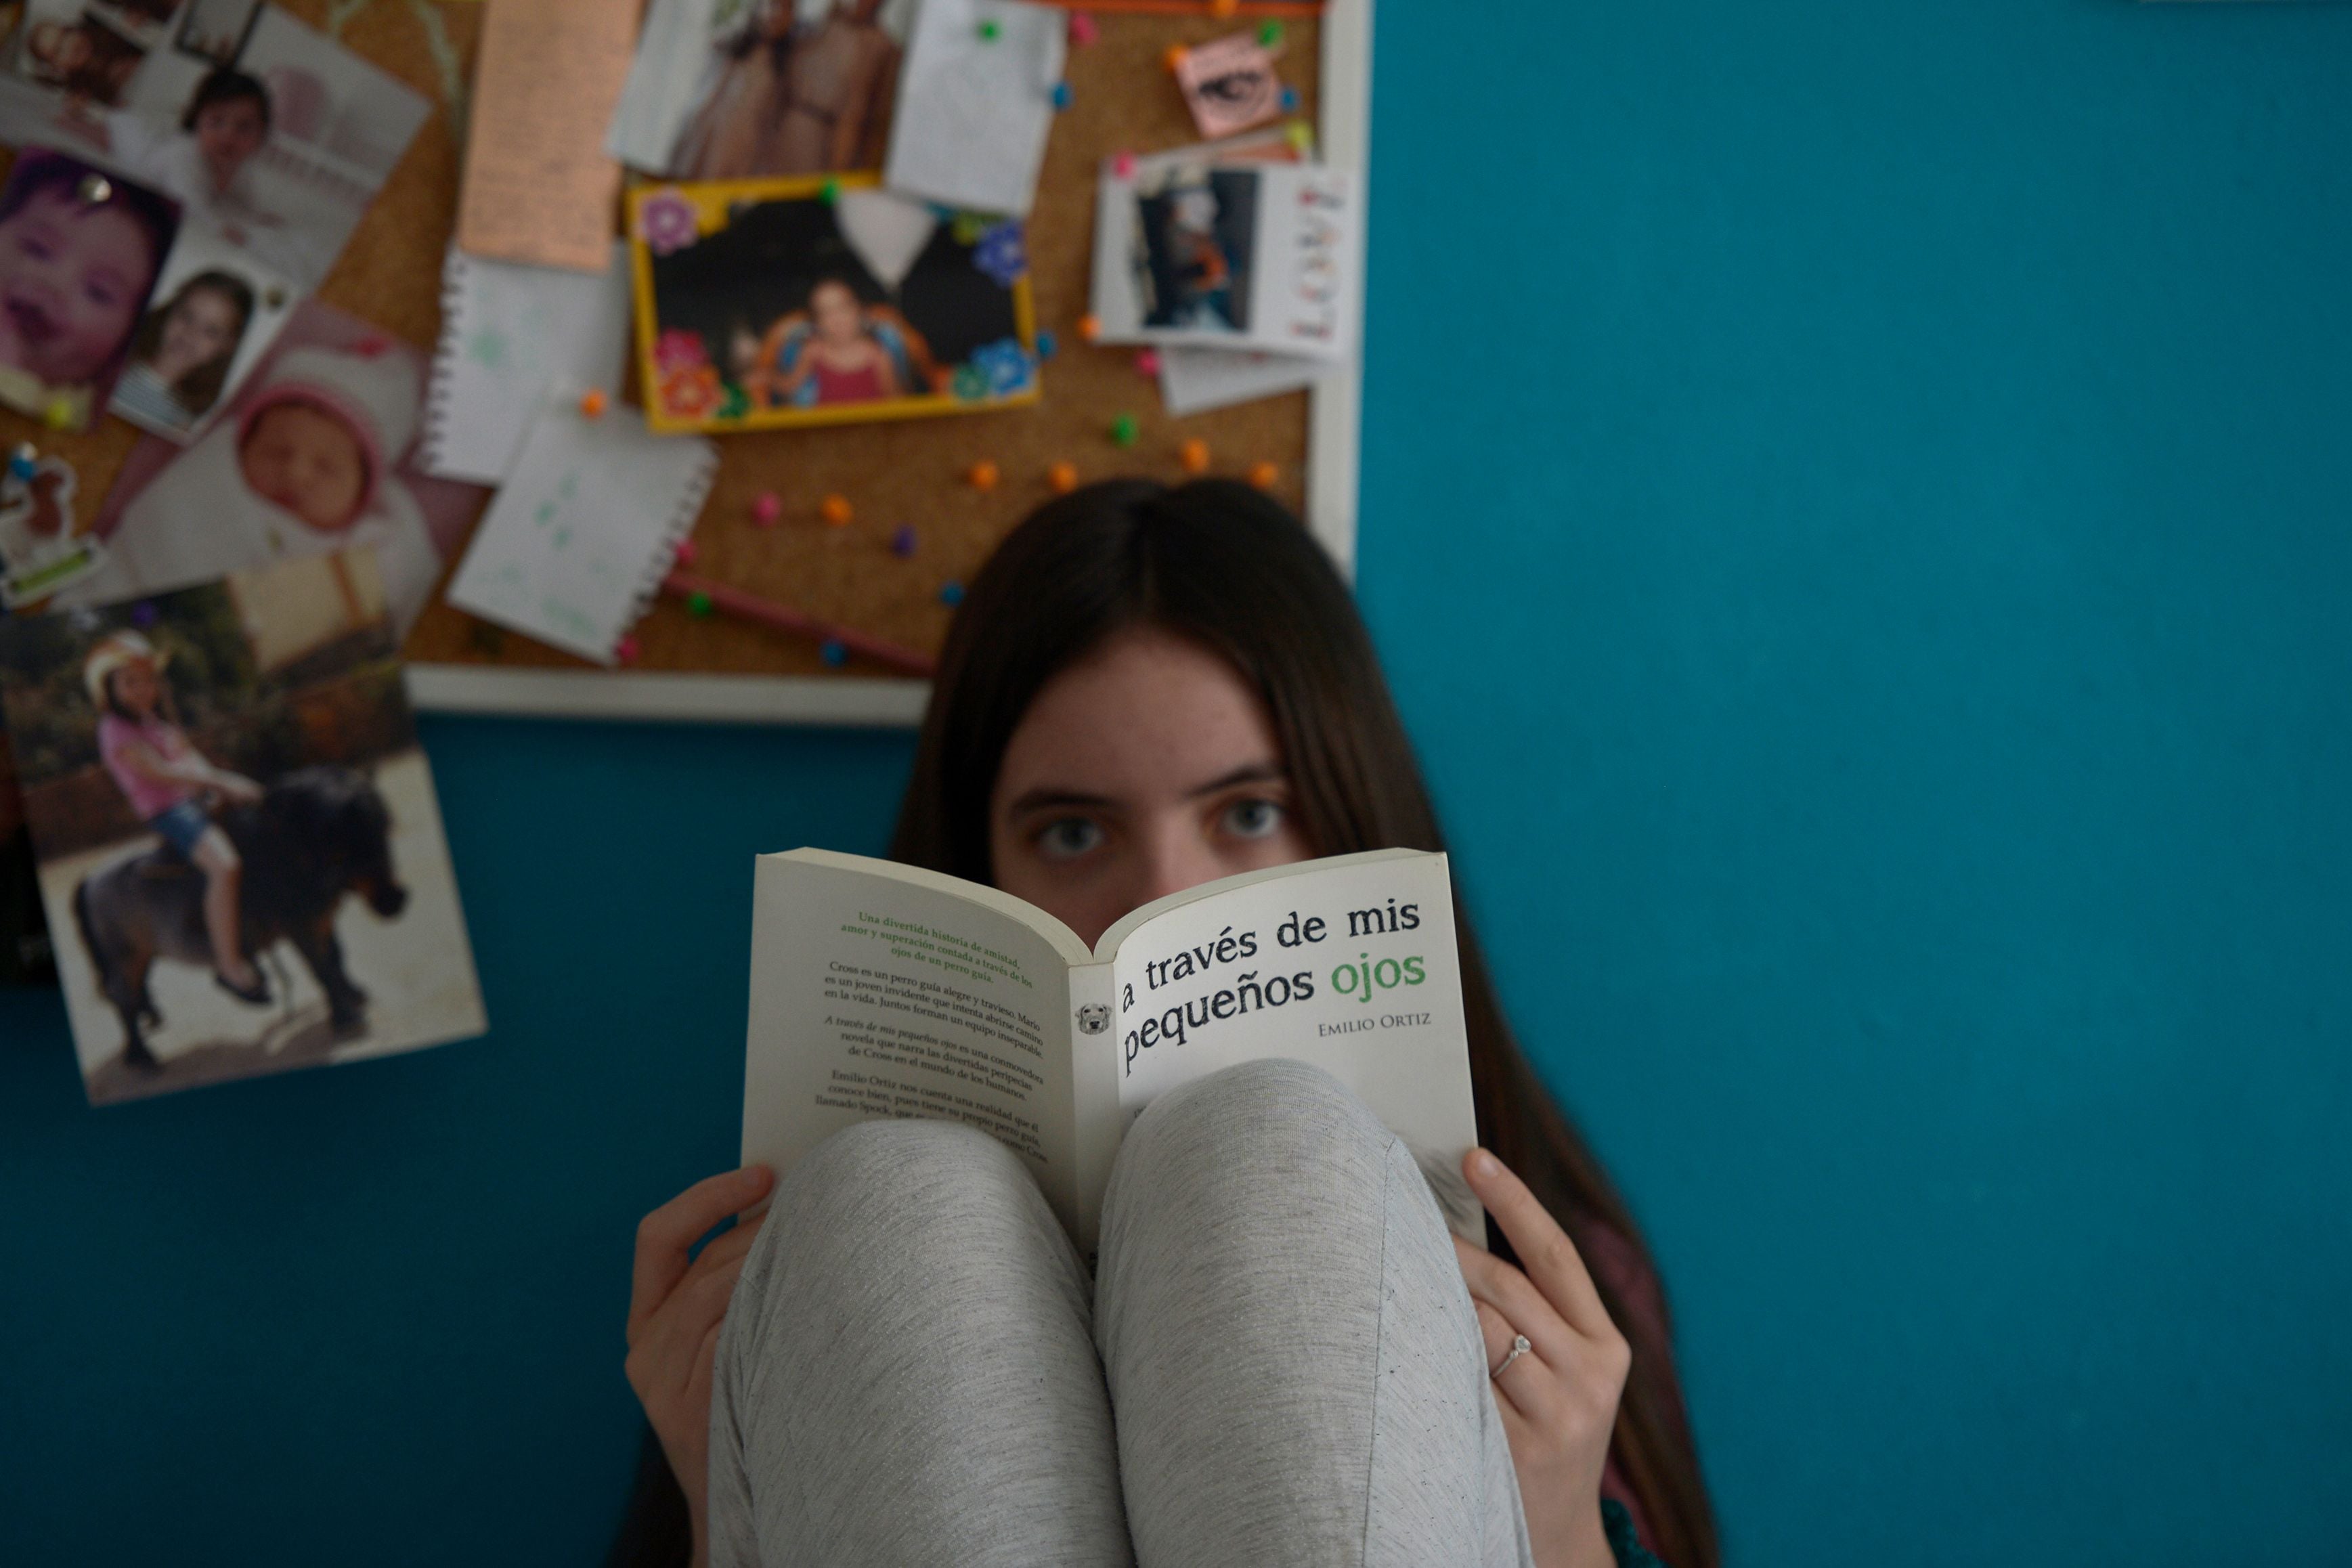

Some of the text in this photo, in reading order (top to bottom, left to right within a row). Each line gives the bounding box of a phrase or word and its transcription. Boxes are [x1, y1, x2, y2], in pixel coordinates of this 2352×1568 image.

[841, 924, 868, 935] amor
[871, 930, 877, 939] y
[880, 932, 935, 951] superación
[938, 946, 973, 963] contada
[983, 959, 1008, 976] través
[1010, 971, 1020, 982] de
[1022, 975, 1032, 988] los
[858, 911, 1020, 970] Una divertida historia de amistad,
[891, 947, 995, 983] ojos de un perro guía.
[1121, 898, 1421, 1013] a través de mis
[825, 976, 1043, 1046] es un joven invidente que intenta abrirse camino
[825, 989, 1043, 1059] en la vida. Juntos forman un equipo inseparable.
[829, 961, 1041, 1032] Cross es un perro guía alegre y travieso. Mario
[1125, 953, 1427, 1078] pequeños ojos
[1318, 1012, 1432, 1037] EMILIO ORTIZ
[825, 1016, 1044, 1085] A través de mis pequeños ojos es una conmovedora
[841, 1032, 1033, 1091] novela que narra las divertidas peripecias
[848, 1046, 1028, 1102] de Cross en el mundo de los humanos.
[815, 1094, 858, 1109] llamado
[828, 1085, 865, 1097] conoce
[867, 1088, 892, 1103] bien,
[895, 1095, 919, 1106] pues
[921, 1100, 946, 1112] tiene
[949, 1107, 959, 1116] su
[963, 1110, 993, 1127] propio
[995, 1121, 1020, 1137] perro
[1021, 1132, 1041, 1148] guía,
[832, 1069, 1039, 1133] Emilio Ortiz nos cuenta una realidad que él
